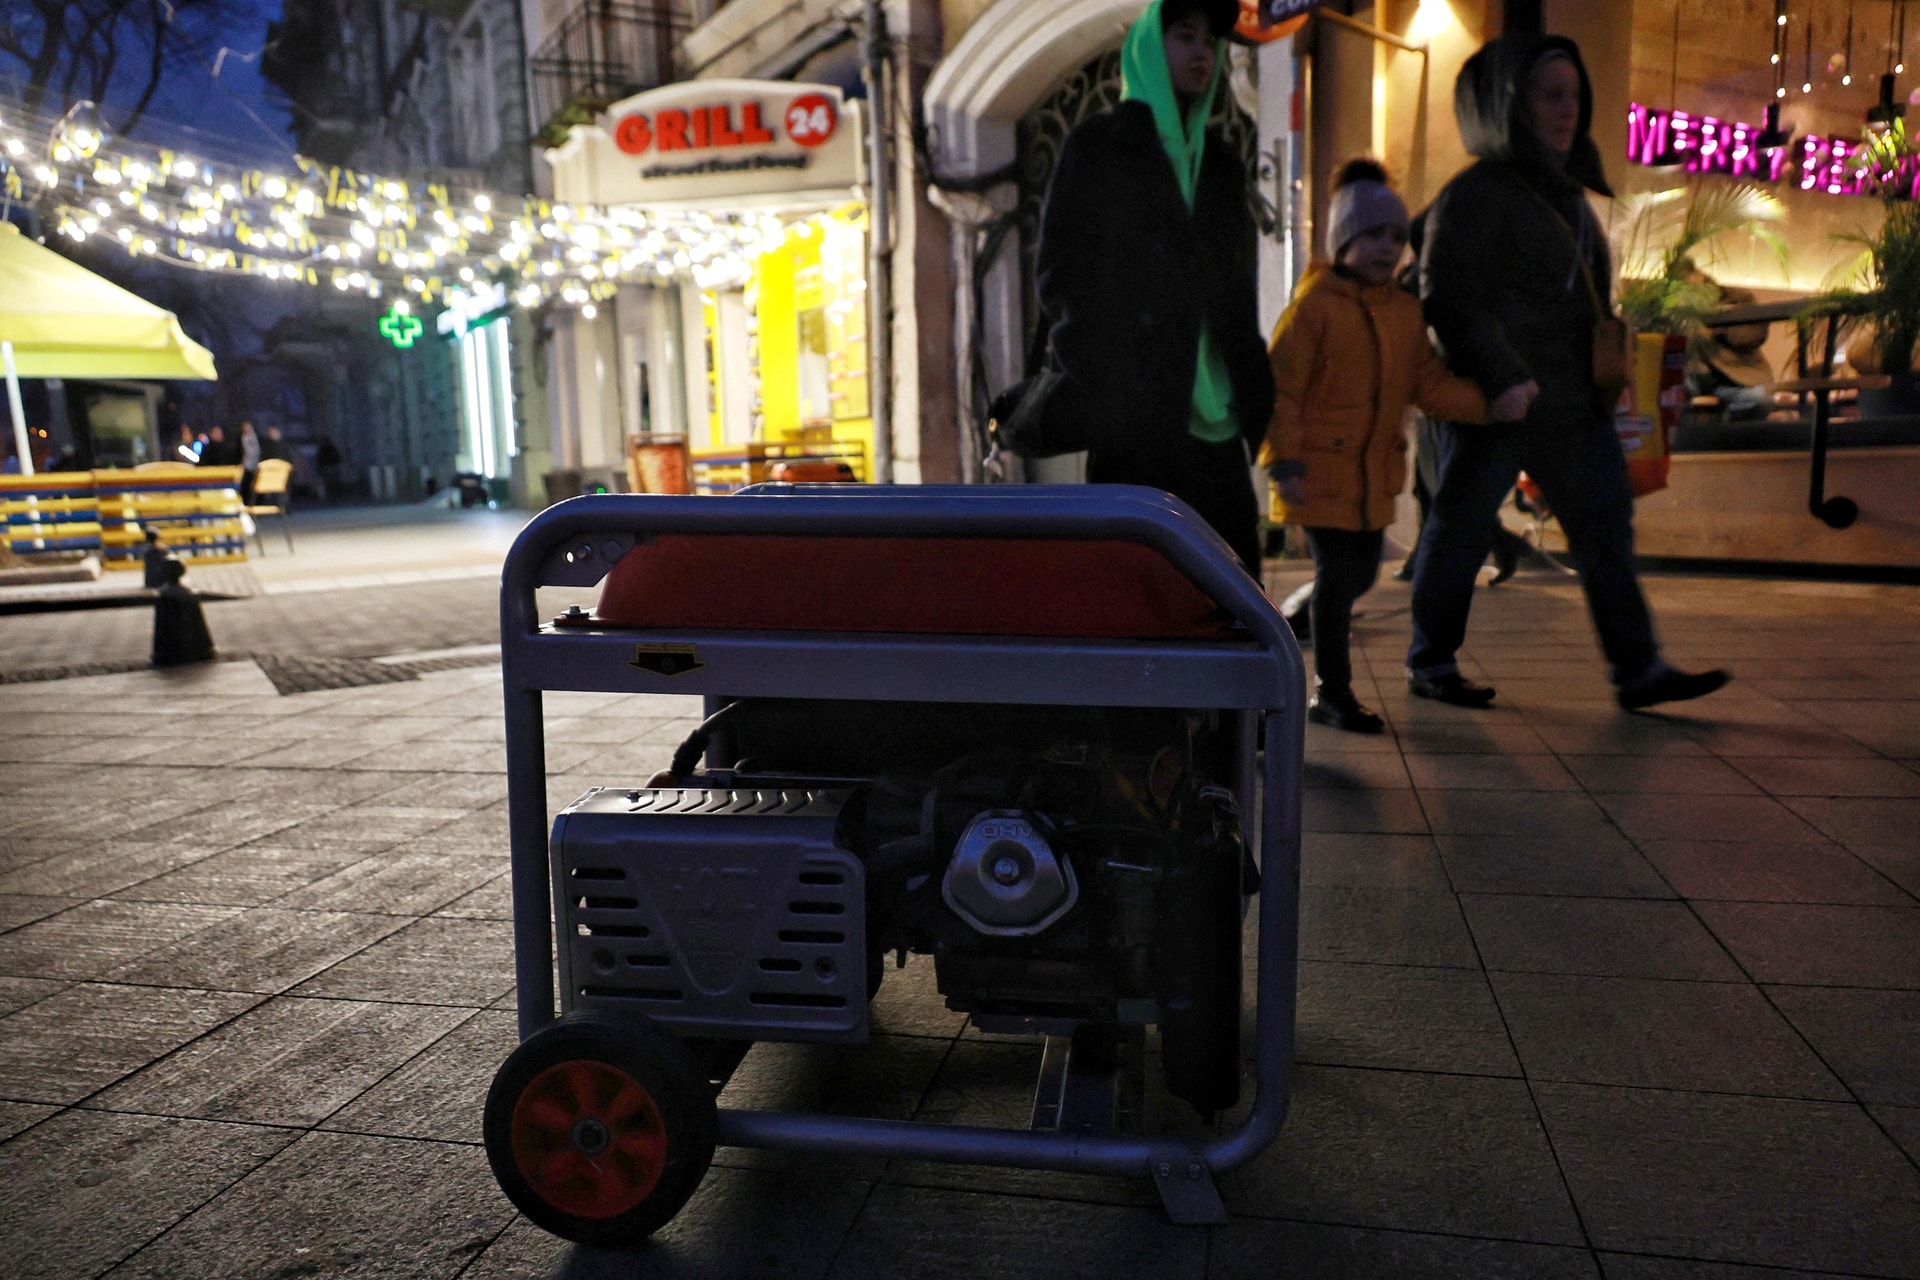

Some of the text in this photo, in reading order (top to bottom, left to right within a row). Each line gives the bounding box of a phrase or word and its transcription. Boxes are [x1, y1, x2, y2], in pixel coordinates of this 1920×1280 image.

[614, 102, 832, 156] GRILL 24
[982, 823, 1033, 838] OHV
